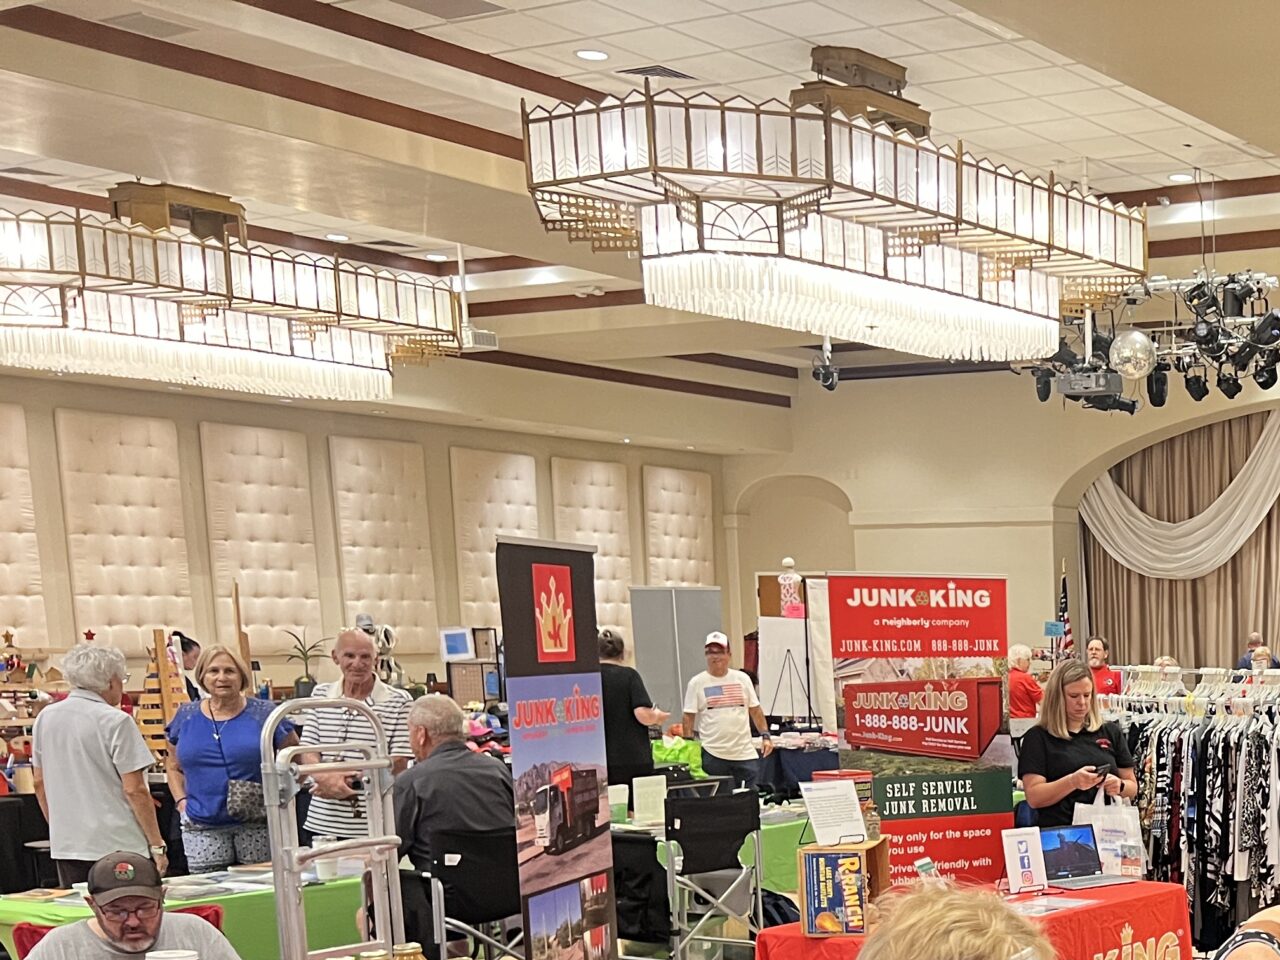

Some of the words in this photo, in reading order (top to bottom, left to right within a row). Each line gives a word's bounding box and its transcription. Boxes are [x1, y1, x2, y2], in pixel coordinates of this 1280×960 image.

[846, 588, 917, 607] JUNK
[929, 585, 992, 608] KING
[873, 619, 880, 627] a
[881, 617, 930, 629] neighborly
[931, 620, 970, 628] company
[840, 639, 922, 653] JUNK-KING.COM
[931, 639, 1000, 652] 888-888-JUNK
[512, 697, 558, 730] JUNK
[563, 688, 600, 724] KING
[852, 692, 900, 710] JUNK
[909, 688, 969, 712] KING
[854, 713, 970, 735] 1-888-888-JUNK
[886, 782, 916, 798] SELF
[922, 779, 973, 796] SERVICE
[883, 800, 916, 815] JUNK
[922, 797, 977, 813] REMOVAL
[906, 830, 928, 843] only
[929, 829, 943, 840] for
[945, 828, 961, 839] the
[963, 828, 992, 840] space
[888, 846, 904, 857] you
[906, 845, 925, 855] use
[934, 859, 970, 873] friendly
[971, 857, 992, 869] with
